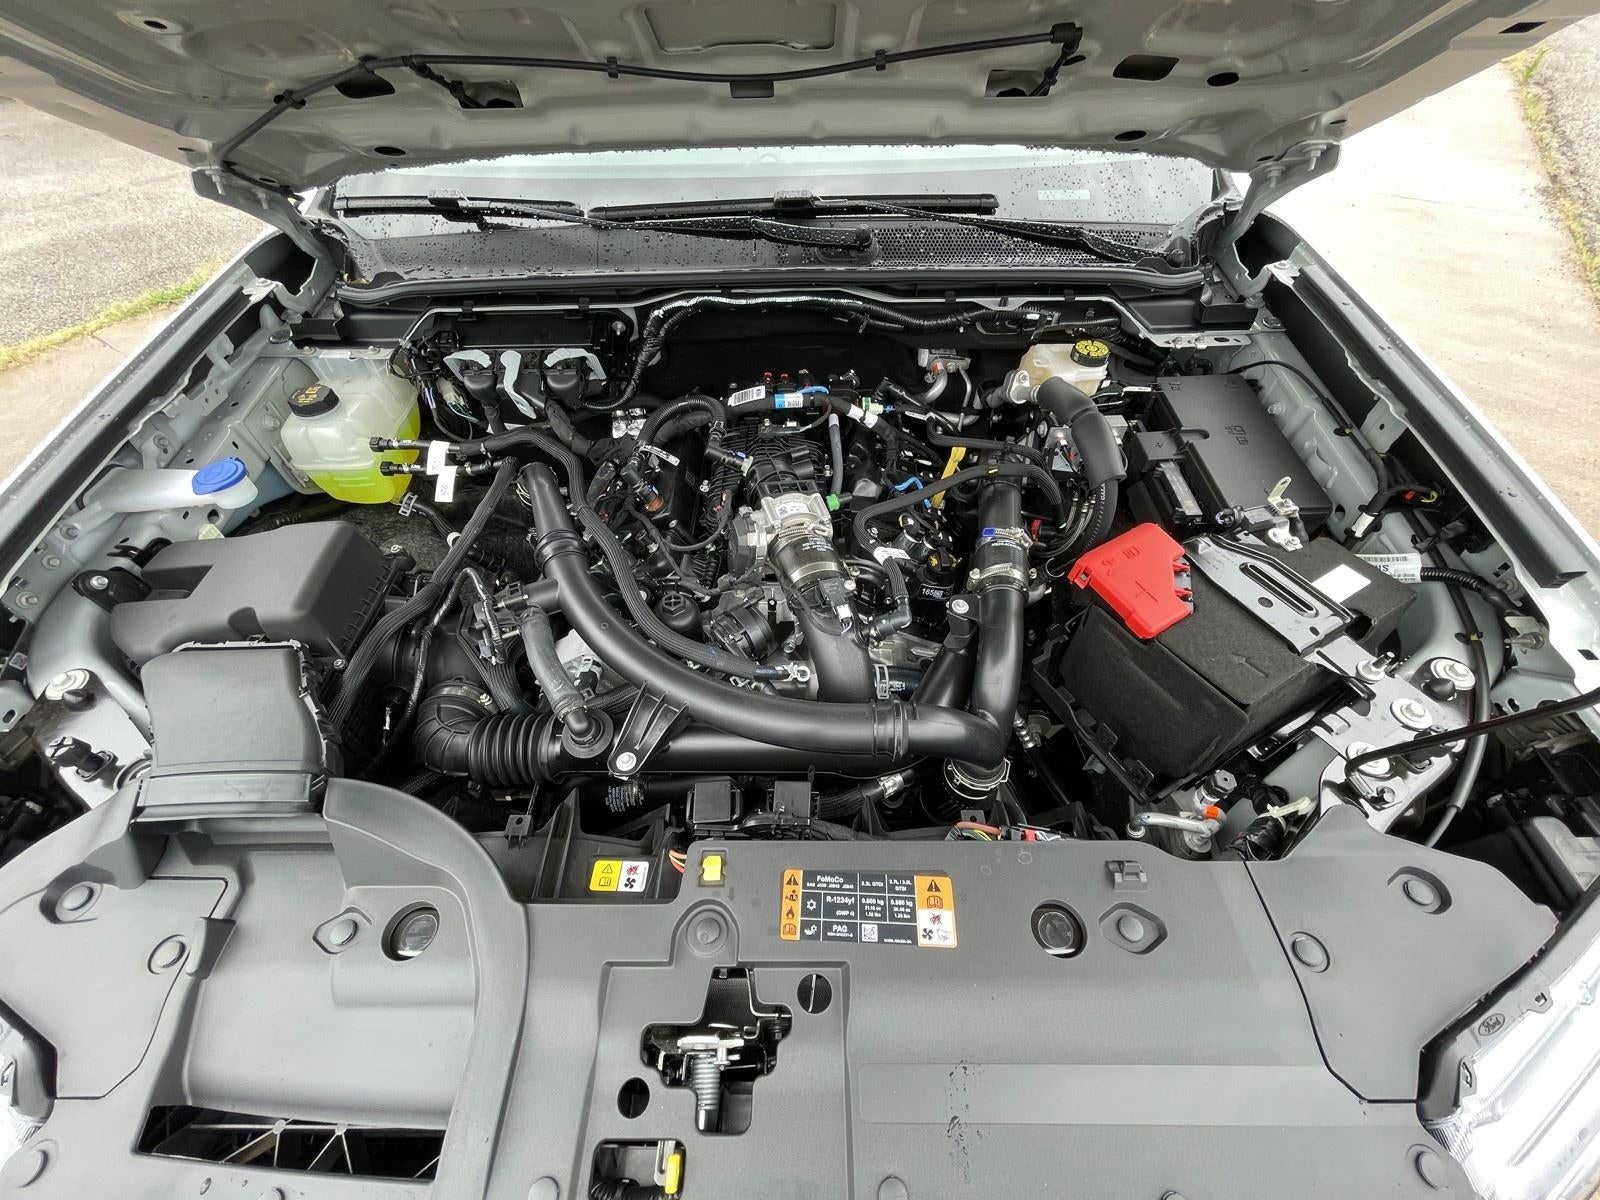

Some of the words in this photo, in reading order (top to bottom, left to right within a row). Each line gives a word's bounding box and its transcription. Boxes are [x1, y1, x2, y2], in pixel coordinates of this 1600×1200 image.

[816, 875, 844, 883] FoMoCo
[826, 896, 855, 905] R-1234yf
[877, 898, 885, 906] kg
[832, 924, 848, 932] PAG
[1483, 1017, 1501, 1033] Ford
